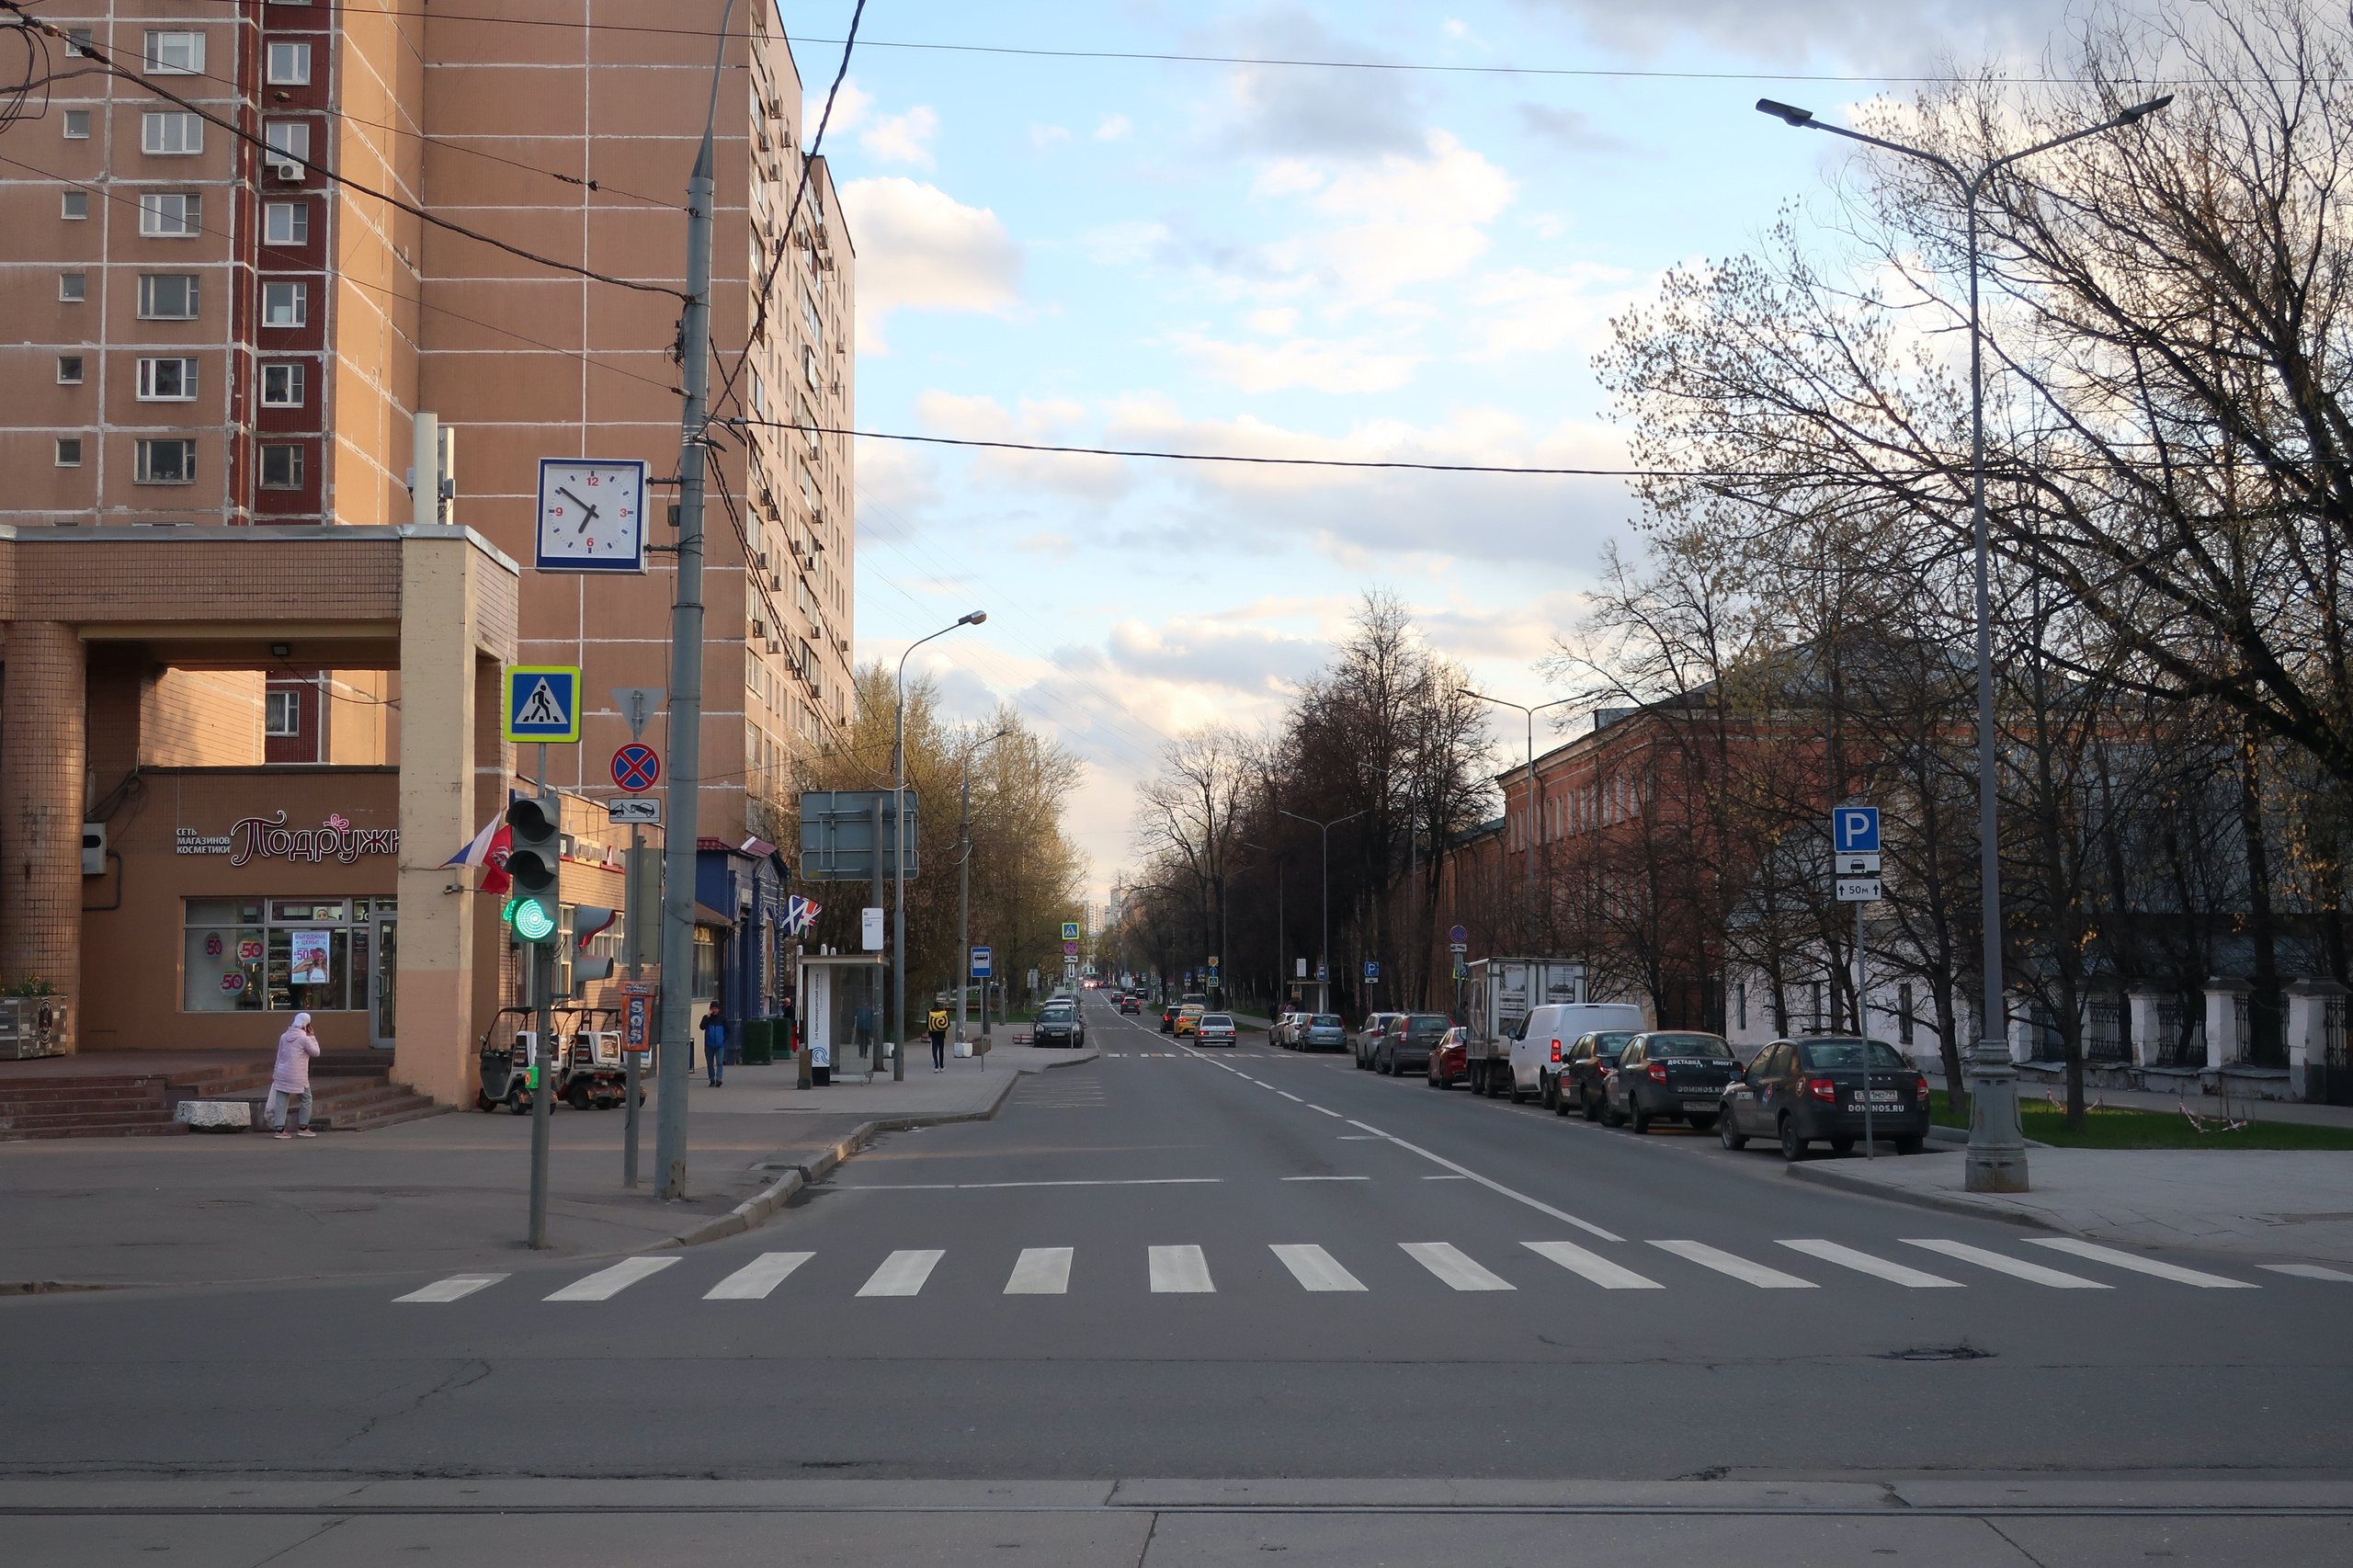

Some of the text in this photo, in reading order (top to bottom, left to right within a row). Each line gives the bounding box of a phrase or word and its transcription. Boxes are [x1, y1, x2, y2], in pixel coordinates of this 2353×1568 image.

[586, 476, 599, 486] 12
[555, 506, 563, 517] 9
[620, 508, 628, 517] 3
[586, 538, 595, 547] 6
[1845, 812, 1870, 847] P
[177, 836, 230, 845] МАГАЗИНОВ
[176, 846, 230, 854] КОСМЕТИКИ
[631, 1001, 643, 1040] SOS
[1847, 1104, 1904, 1112] DOMNOS.RU
